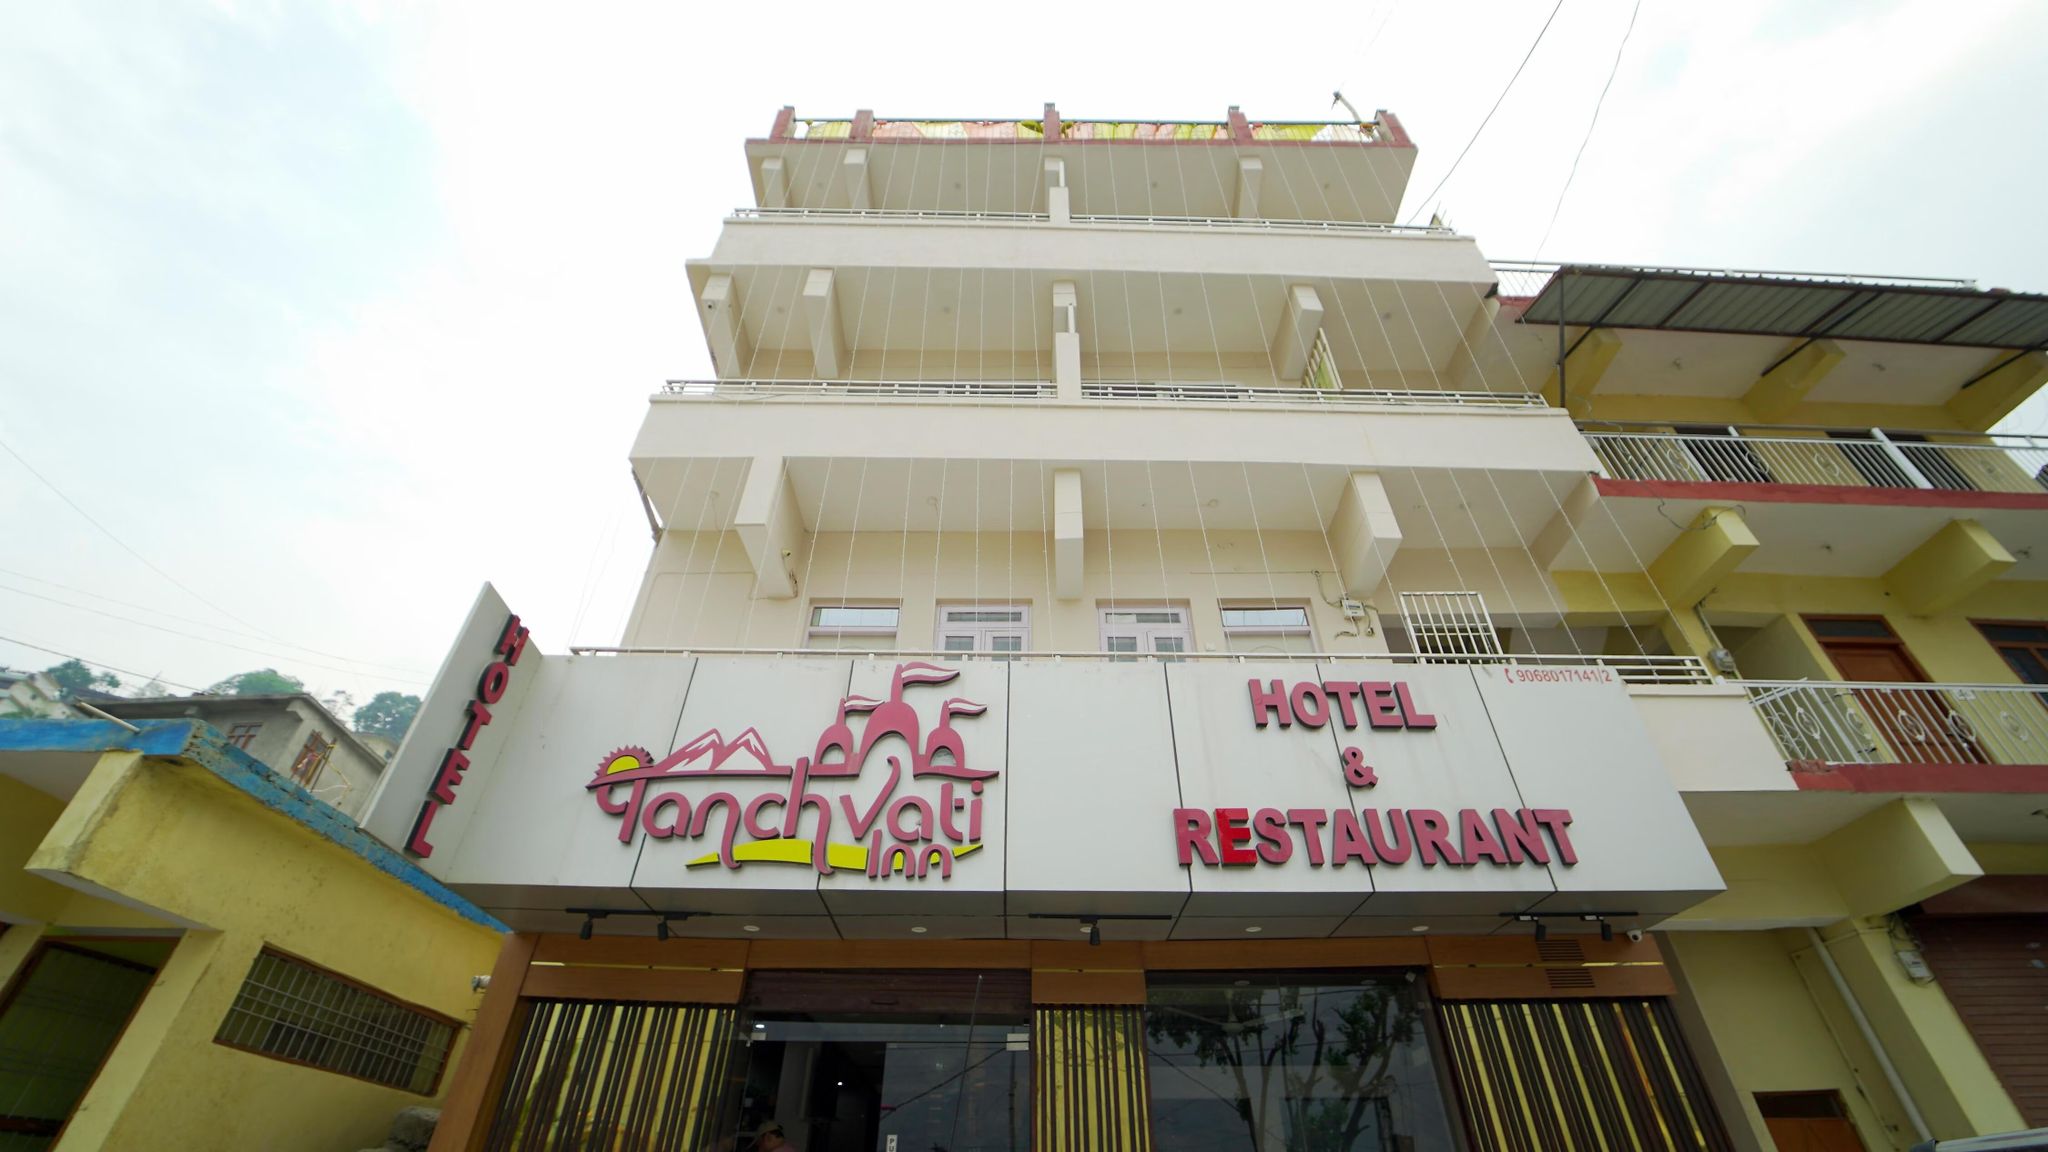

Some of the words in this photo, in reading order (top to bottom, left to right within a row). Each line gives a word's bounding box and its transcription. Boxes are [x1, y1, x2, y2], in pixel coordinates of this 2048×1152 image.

[1247, 678, 1438, 730] HOTEL
[403, 613, 530, 859] HOTEL
[1341, 746, 1378, 788] &
[1172, 807, 1579, 867] RESTAURANT
